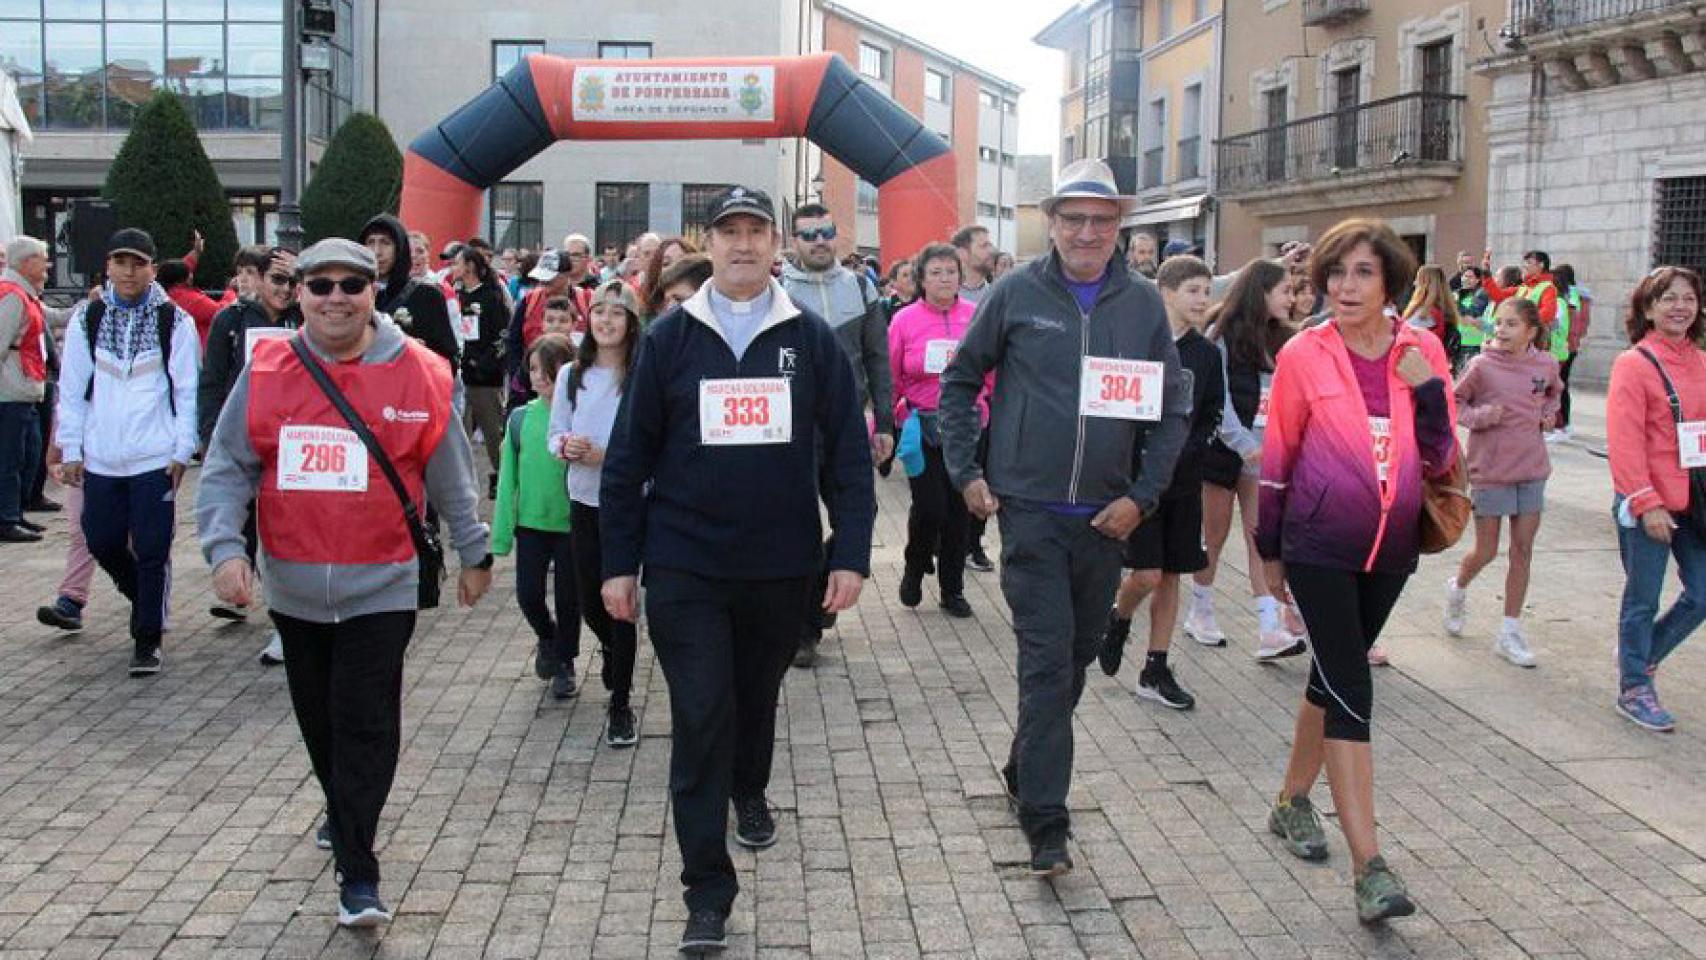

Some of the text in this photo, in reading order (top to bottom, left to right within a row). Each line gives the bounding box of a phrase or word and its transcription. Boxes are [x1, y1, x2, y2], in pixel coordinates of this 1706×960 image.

[615, 72, 728, 83] AYUNTAMIENTO
[611, 86, 730, 98] DE PONFERRADA
[650, 105, 663, 113] DE
[671, 104, 728, 113] DEPORTES
[1101, 374, 1142, 402] 384
[724, 397, 769, 426] 333
[300, 444, 346, 473] 296
